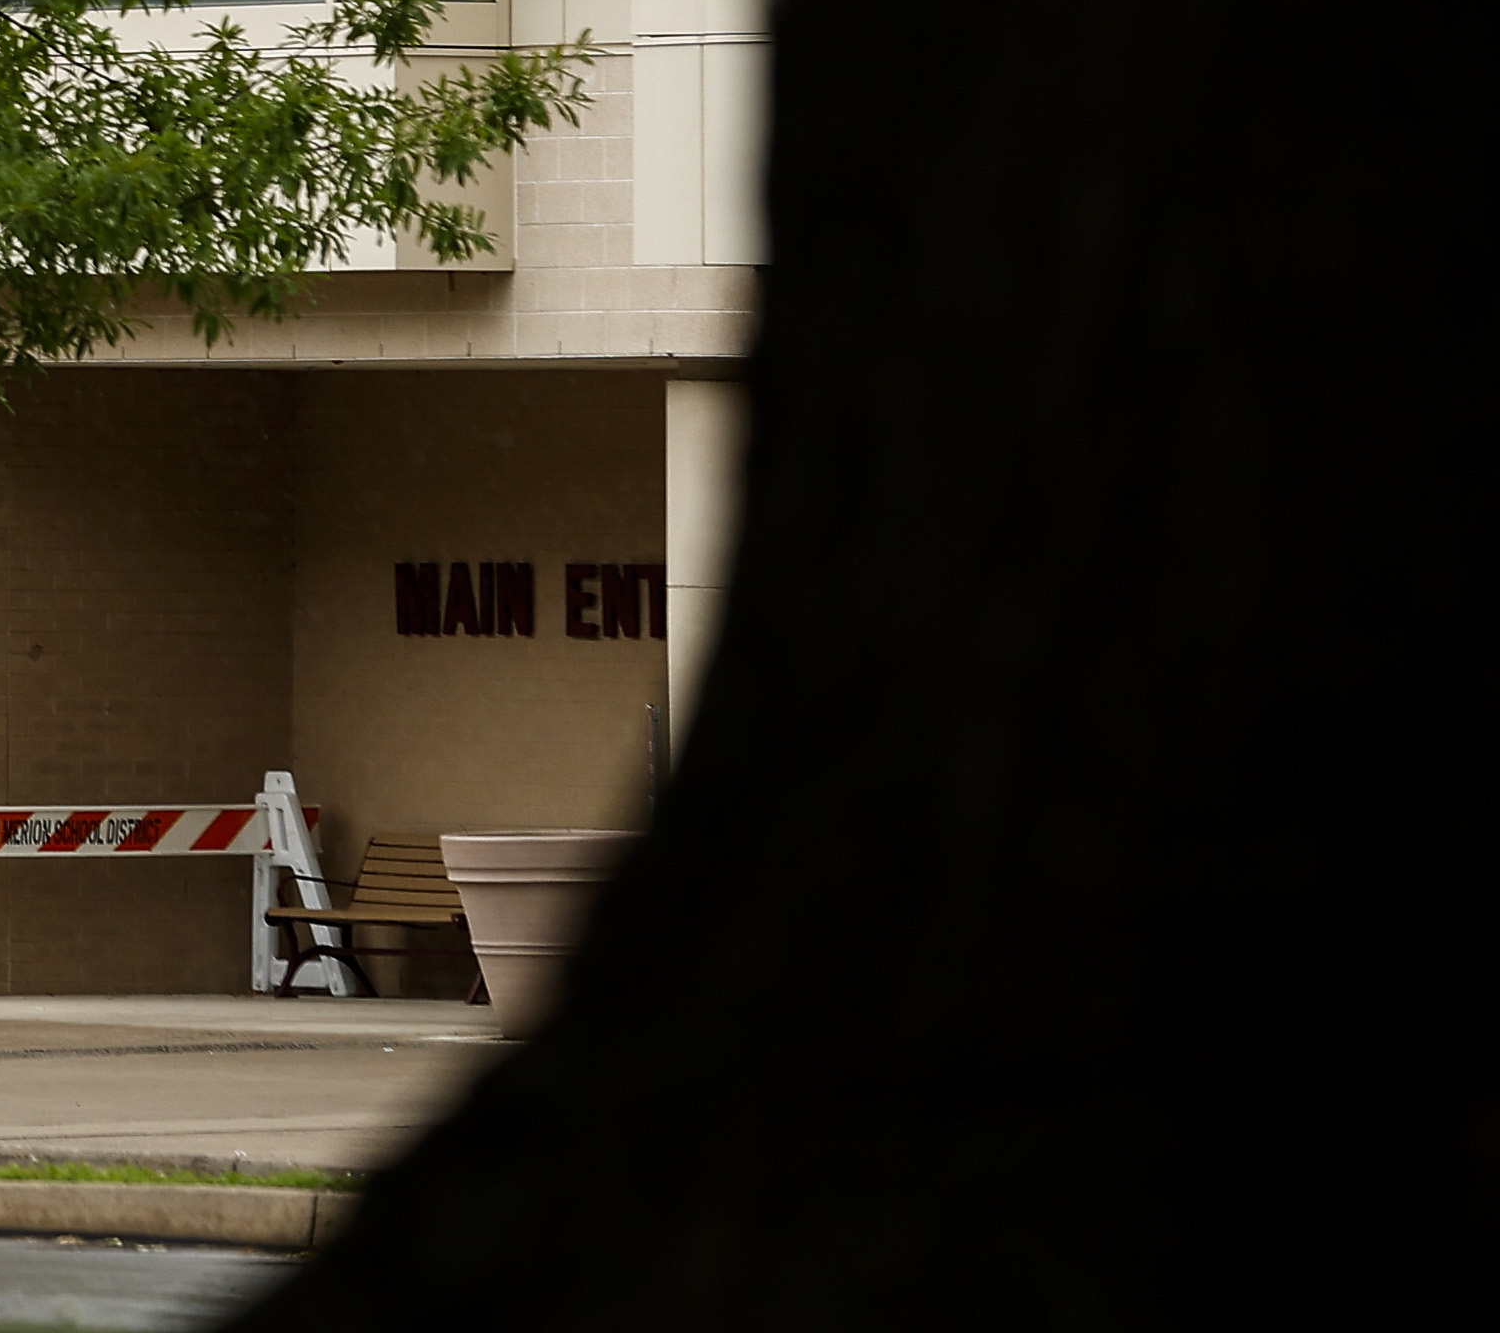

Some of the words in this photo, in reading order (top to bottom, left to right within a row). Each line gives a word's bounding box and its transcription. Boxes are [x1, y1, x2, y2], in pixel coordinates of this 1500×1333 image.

[394, 561, 535, 639] MAIN
[3, 818, 51, 846] MERION
[53, 818, 105, 845] SCHOOL
[106, 817, 163, 845] DISTRICT
